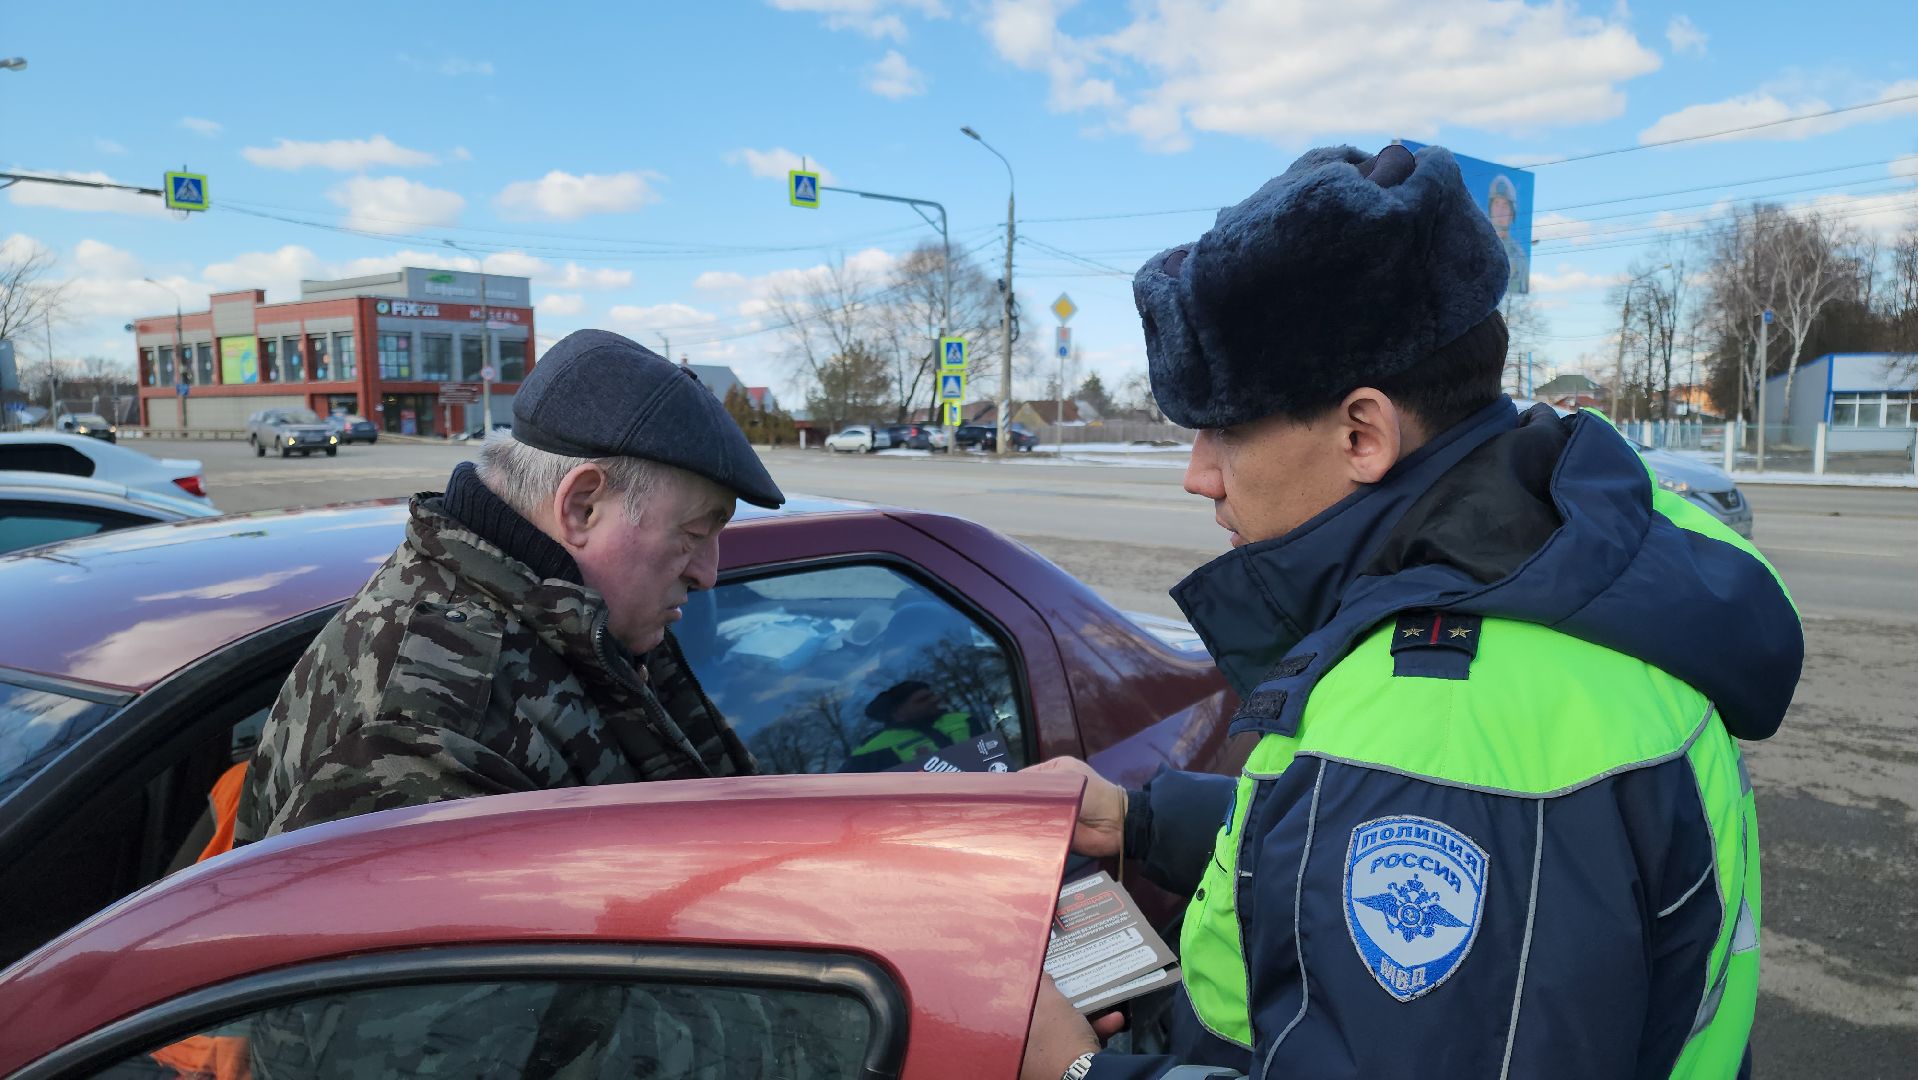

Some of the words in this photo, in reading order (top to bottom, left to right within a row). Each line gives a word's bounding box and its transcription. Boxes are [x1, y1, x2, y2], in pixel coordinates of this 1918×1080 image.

[1361, 825, 1478, 874] ПОЛИЦИЯ
[1370, 853, 1461, 893] РОССИЯ
[1381, 957, 1426, 990] МВД
